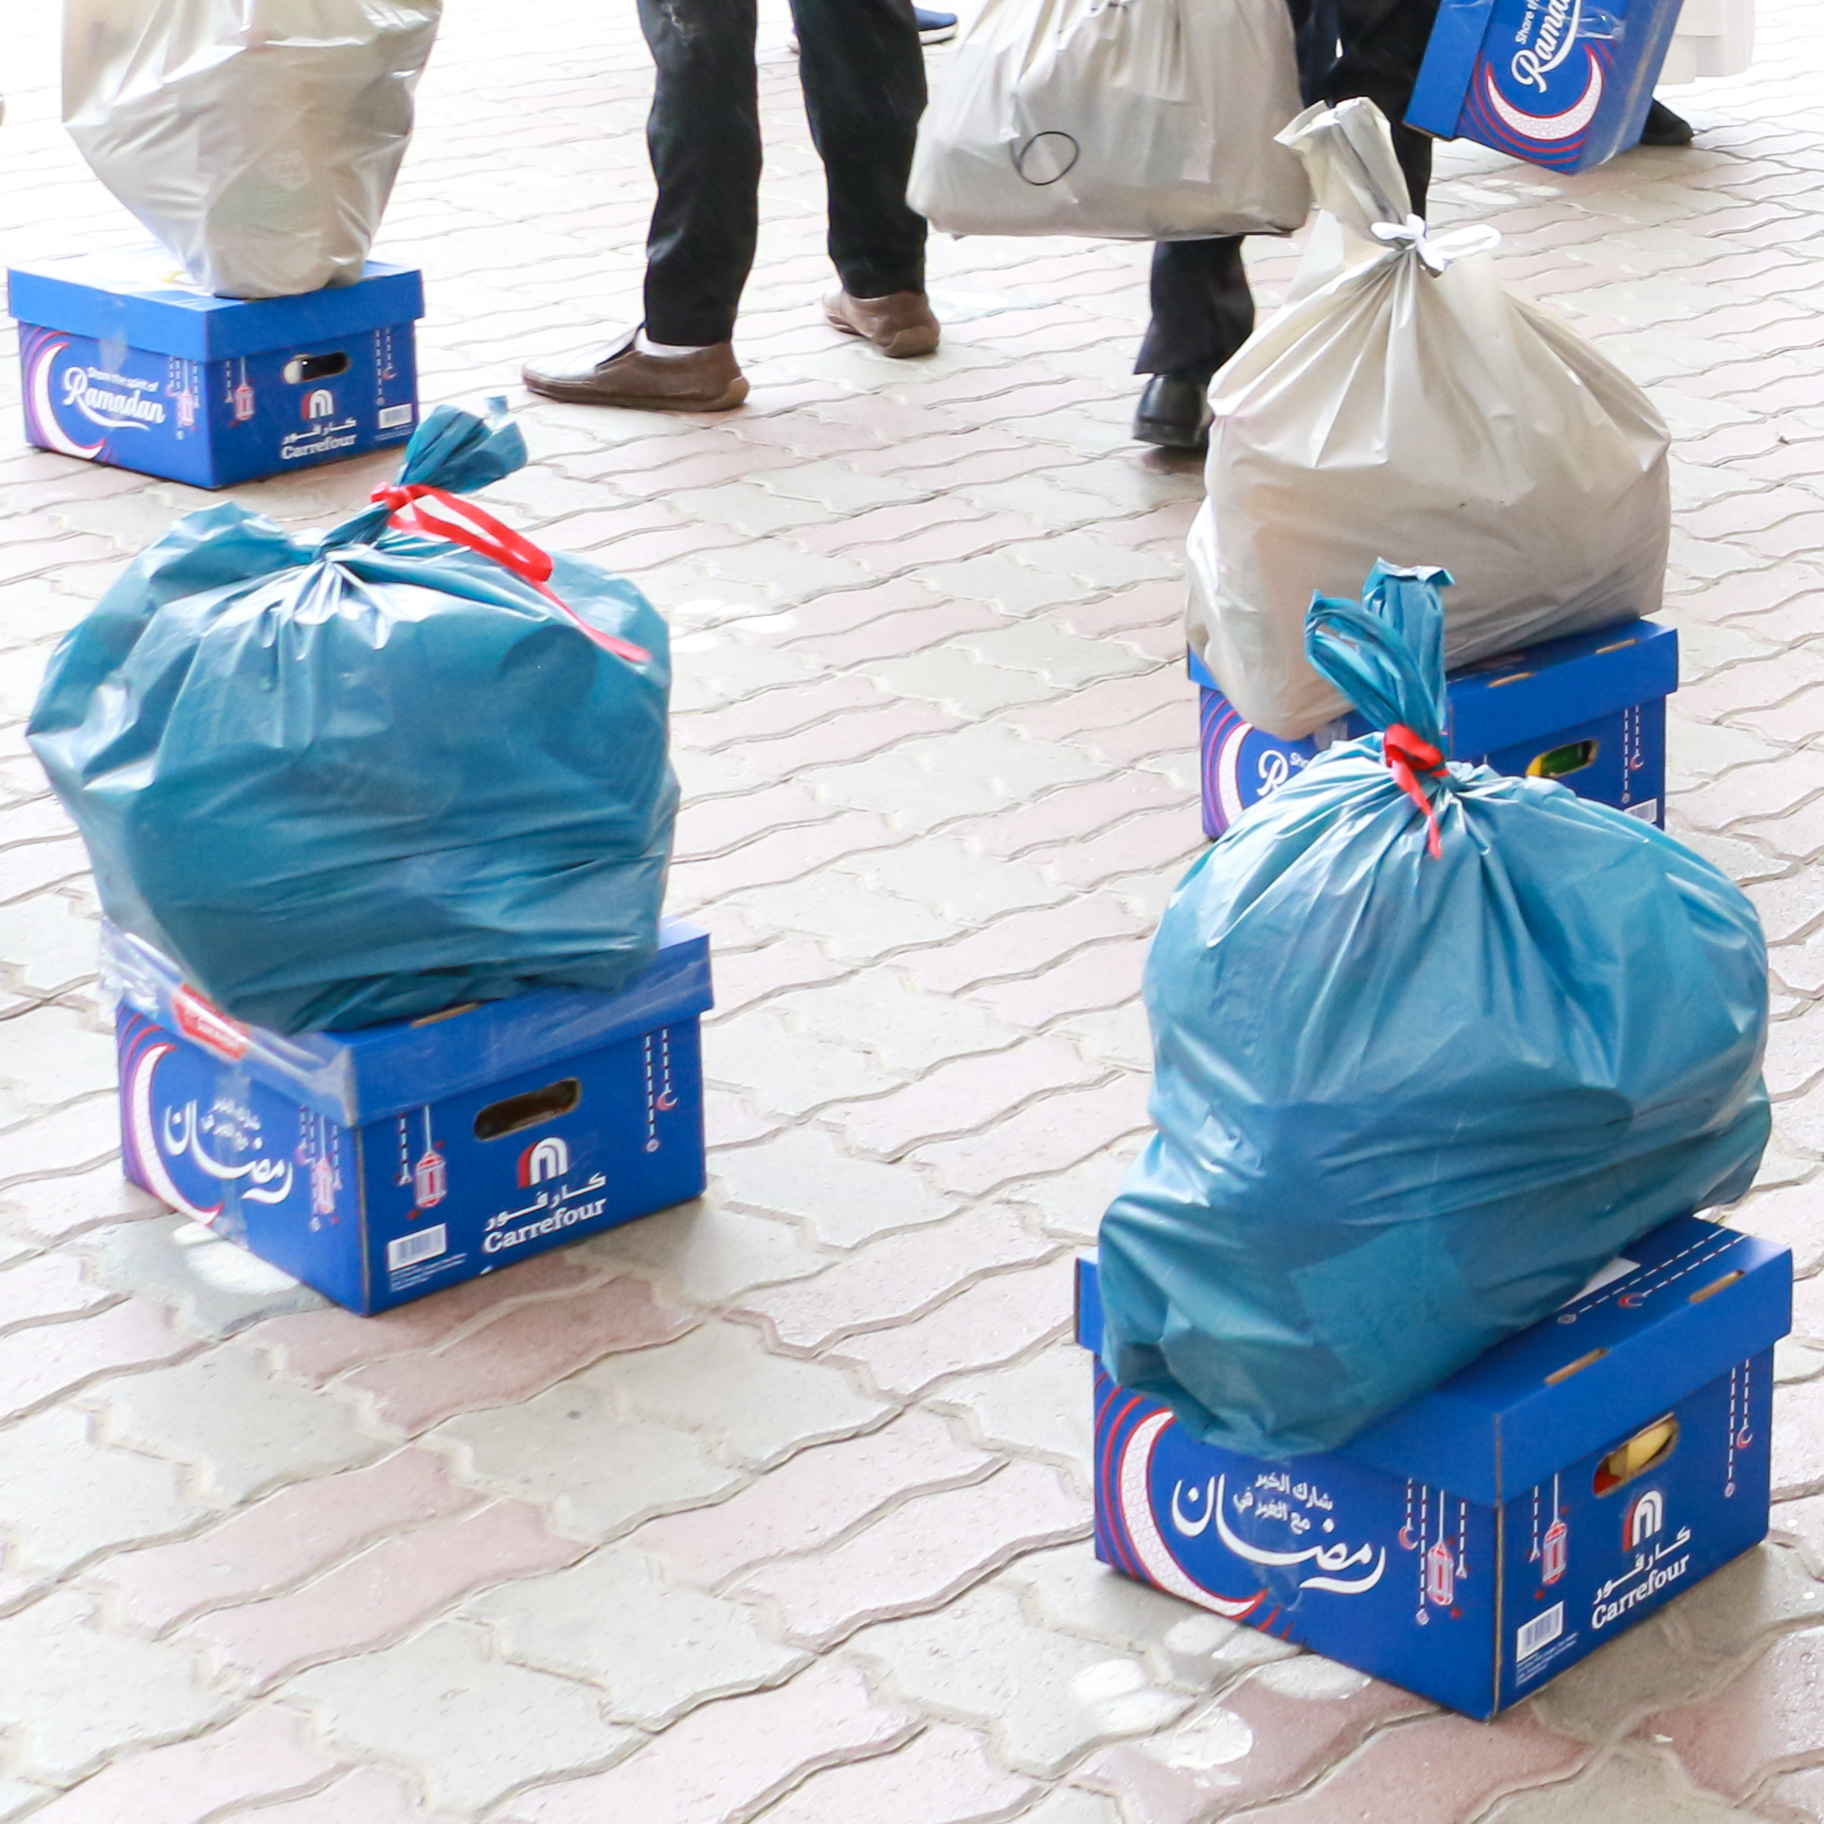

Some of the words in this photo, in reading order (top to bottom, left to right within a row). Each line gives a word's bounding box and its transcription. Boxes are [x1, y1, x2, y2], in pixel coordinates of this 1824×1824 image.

[1515, 10, 1535, 45] Share
[62, 366, 166, 431] Ramadan
[281, 417, 357, 445] كارفور
[281, 434, 357, 460] Carrefour
[163, 1098, 293, 1205] رمضان
[484, 1172, 607, 1232] كارفور
[482, 1197, 608, 1254] Carrefour
[1233, 1487, 1254, 1514] في
[1255, 1472, 1290, 1495] الخير
[1292, 1482, 1334, 1511] شارك
[1254, 1498, 1289, 1522] الغير
[1290, 1511, 1311, 1535] مع
[1171, 1473, 1386, 1595] رمضان
[1593, 1525, 1691, 1605] كارفور
[1591, 1554, 1690, 1630] Carrefour
